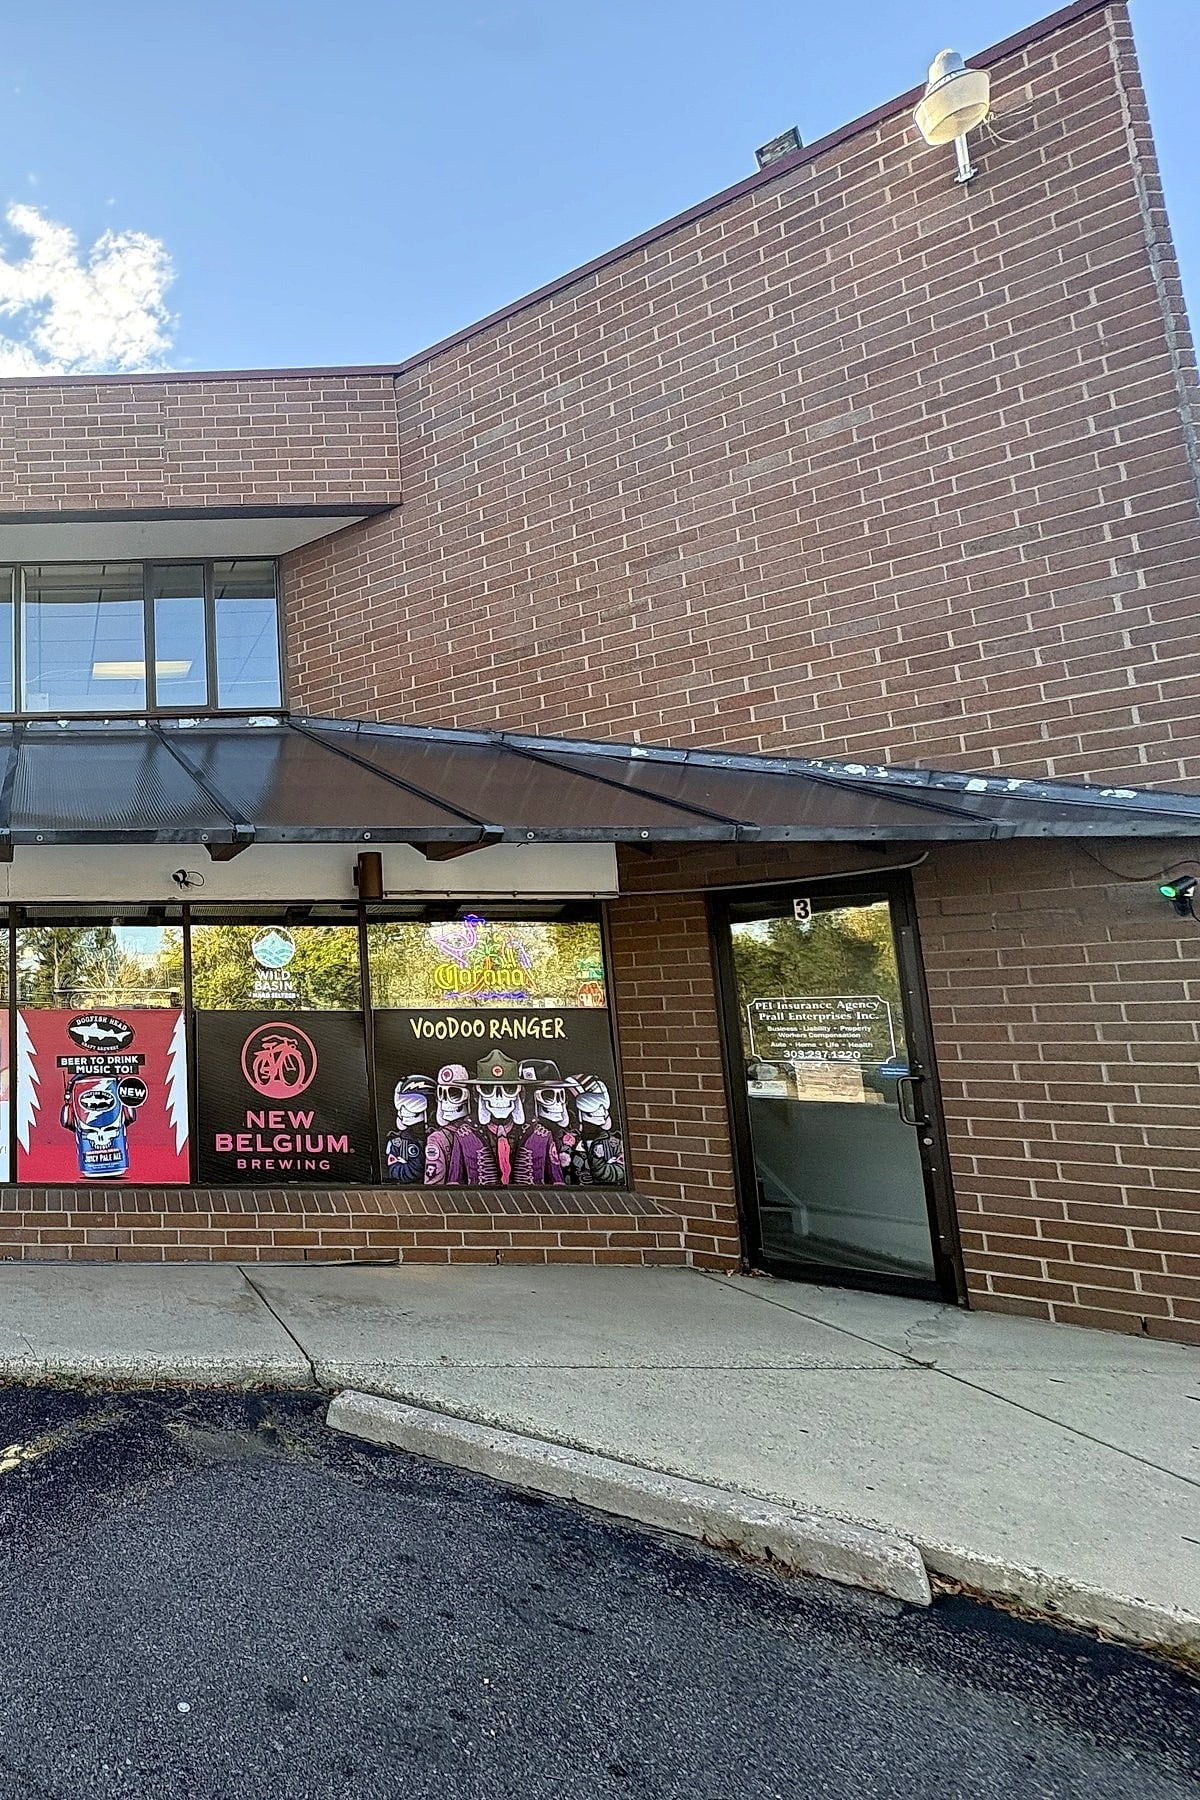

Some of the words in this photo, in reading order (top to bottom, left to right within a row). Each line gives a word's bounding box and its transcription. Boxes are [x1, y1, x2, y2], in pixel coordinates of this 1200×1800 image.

[796, 900, 810, 919] 3
[255, 969, 290, 980] WILD
[435, 963, 525, 991] Corona
[254, 981, 293, 991] BASIN
[755, 1002, 773, 1010] PEI
[777, 1001, 832, 1010] Insurance
[836, 1000, 880, 1012] Agency
[759, 1012, 784, 1021] Prall
[788, 1012, 852, 1023] Enterprises
[856, 1011, 879, 1020] Inc.
[76, 1016, 108, 1025] DOGFISH
[109, 1018, 128, 1031] HEAD
[409, 1016, 486, 1040] VOODOO
[489, 1016, 566, 1040] RANGER
[61, 1057, 87, 1066] BEER
[90, 1056, 104, 1065] TO
[107, 1055, 139, 1064] DRINK
[75, 1065, 110, 1074] MUSIC
[114, 1065, 133, 1074] TO!
[119, 1086, 146, 1097] NEW
[246, 1110, 315, 1129] NEW
[215, 1133, 348, 1153] BELGIUM
[99, 1153, 113, 1162] PALE
[113, 1152, 122, 1161] ALE
[237, 1159, 330, 1170] BREWING
